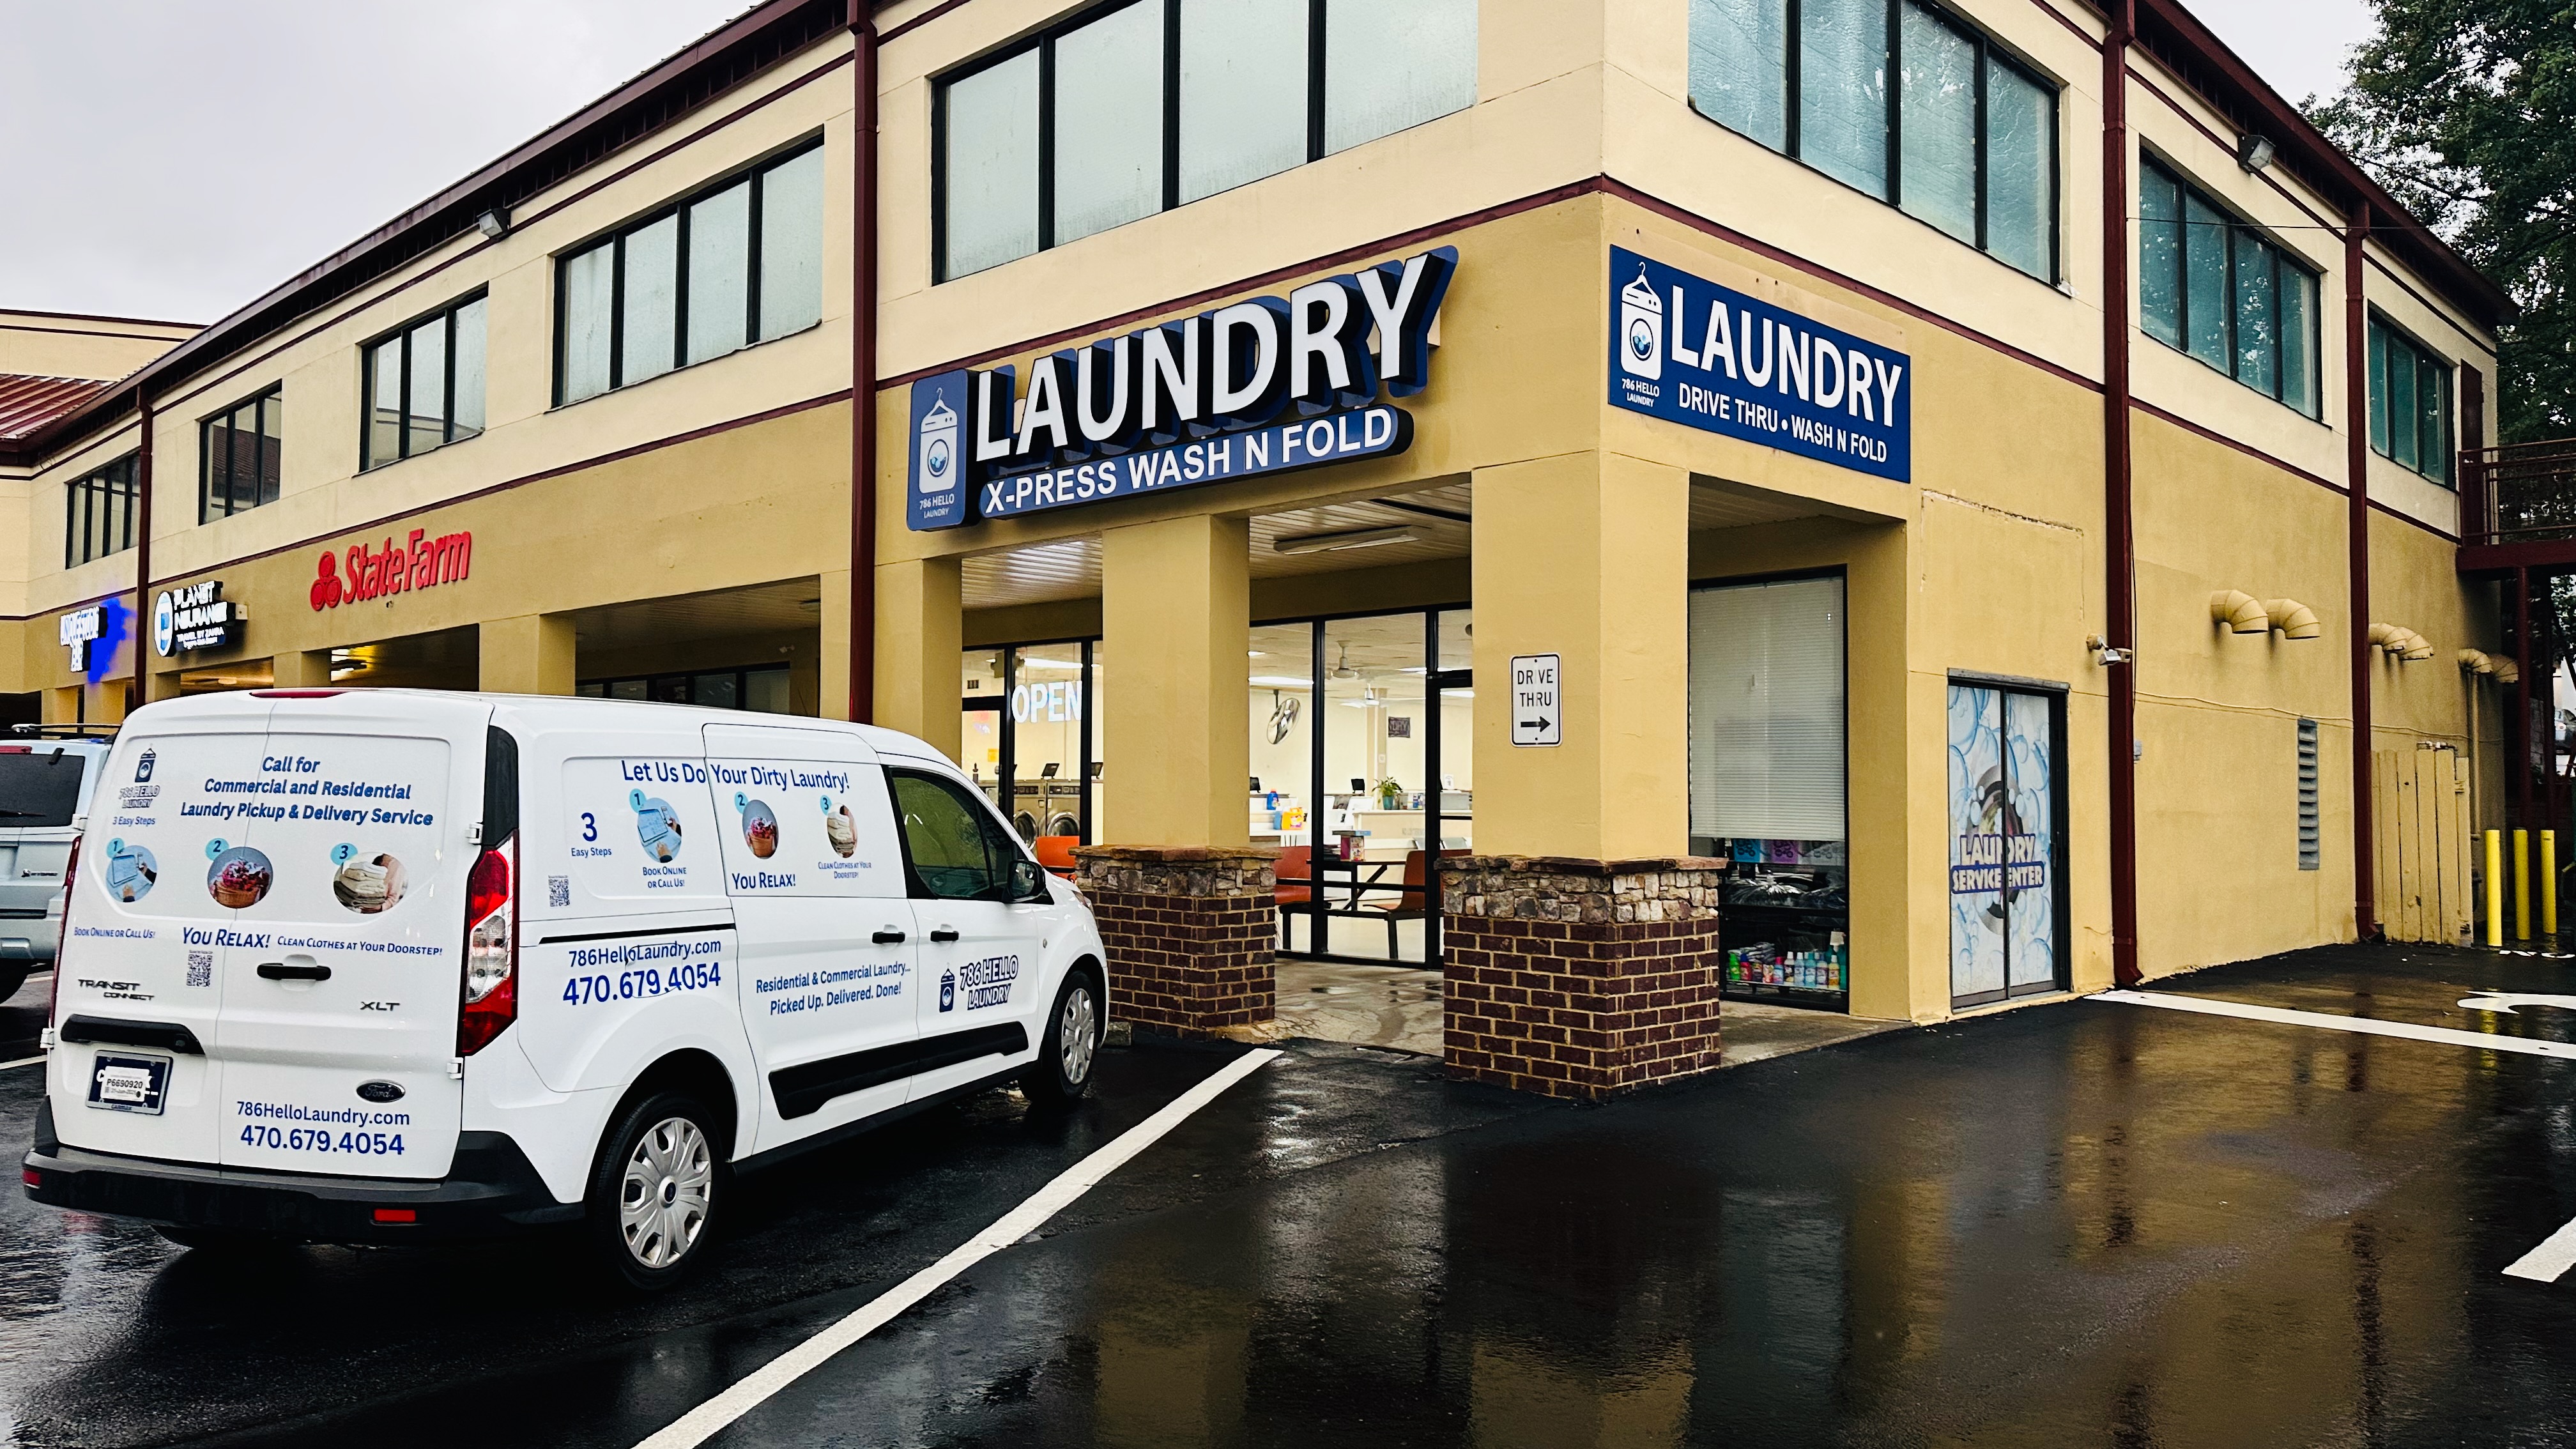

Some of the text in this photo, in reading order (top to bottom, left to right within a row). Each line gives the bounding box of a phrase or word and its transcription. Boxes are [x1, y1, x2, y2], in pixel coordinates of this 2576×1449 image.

[975, 251, 1431, 463] LAUNDRY
[1671, 285, 1902, 427] LAUNDRY
[1621, 378, 1660, 397] 786 HELLO
[1627, 392, 1654, 408] LAUNDRY
[1679, 382, 1887, 463] DRIVE THRU WASH N FOLD
[985, 407, 1393, 514] X-PRESS WASH N FOLD
[919, 493, 954, 510] 786 HELLO
[923, 507, 949, 519] LAUNDRY
[1011, 680, 1082, 723] OPEN
[1519, 692, 1551, 707] THRU
[262, 756, 321, 773] Call for
[621, 760, 850, 793] Let Us Do Your Dirty Laundry!
[133, 785, 160, 797] HELLO
[204, 778, 411, 799] Commercial and Residential
[122, 799, 153, 808] LAUNDRY
[634, 792, 641, 806] 1
[738, 793, 746, 806] 2
[823, 797, 829, 810] 3
[112, 816, 156, 827] 3 Easy Steps
[180, 802, 434, 826] Laundry Pickup & Delivery Service
[581, 812, 598, 842] 3
[113, 840, 119, 852] 1
[213, 840, 222, 852] 2
[339, 845, 348, 859] 3
[571, 847, 612, 858] Easy Steps
[732, 871, 796, 890] YOU RELAX!
[1952, 865, 2043, 892] SERVICE ENTER
[183, 926, 213, 946] YOU
[215, 928, 271, 948] RELAX!
[569, 940, 721, 967] 786HelloLaundry.com
[756, 972, 809, 993] Residential
[812, 972, 818, 985] &
[820, 964, 871, 984] Commercial
[960, 954, 1019, 991] 786 HELLO
[77, 979, 141, 991] TRANSIT
[563, 962, 721, 1006] 470.679.4054
[103, 992, 155, 1001] CONNECT
[360, 1001, 401, 1011] XLT
[770, 981, 901, 1016] Picked Up. Delivered. Done!
[967, 983, 1012, 1010] LAUNDRY
[236, 1101, 410, 1128] 786HelloLaundry.com
[240, 1124, 405, 1155] 470.679.4054
